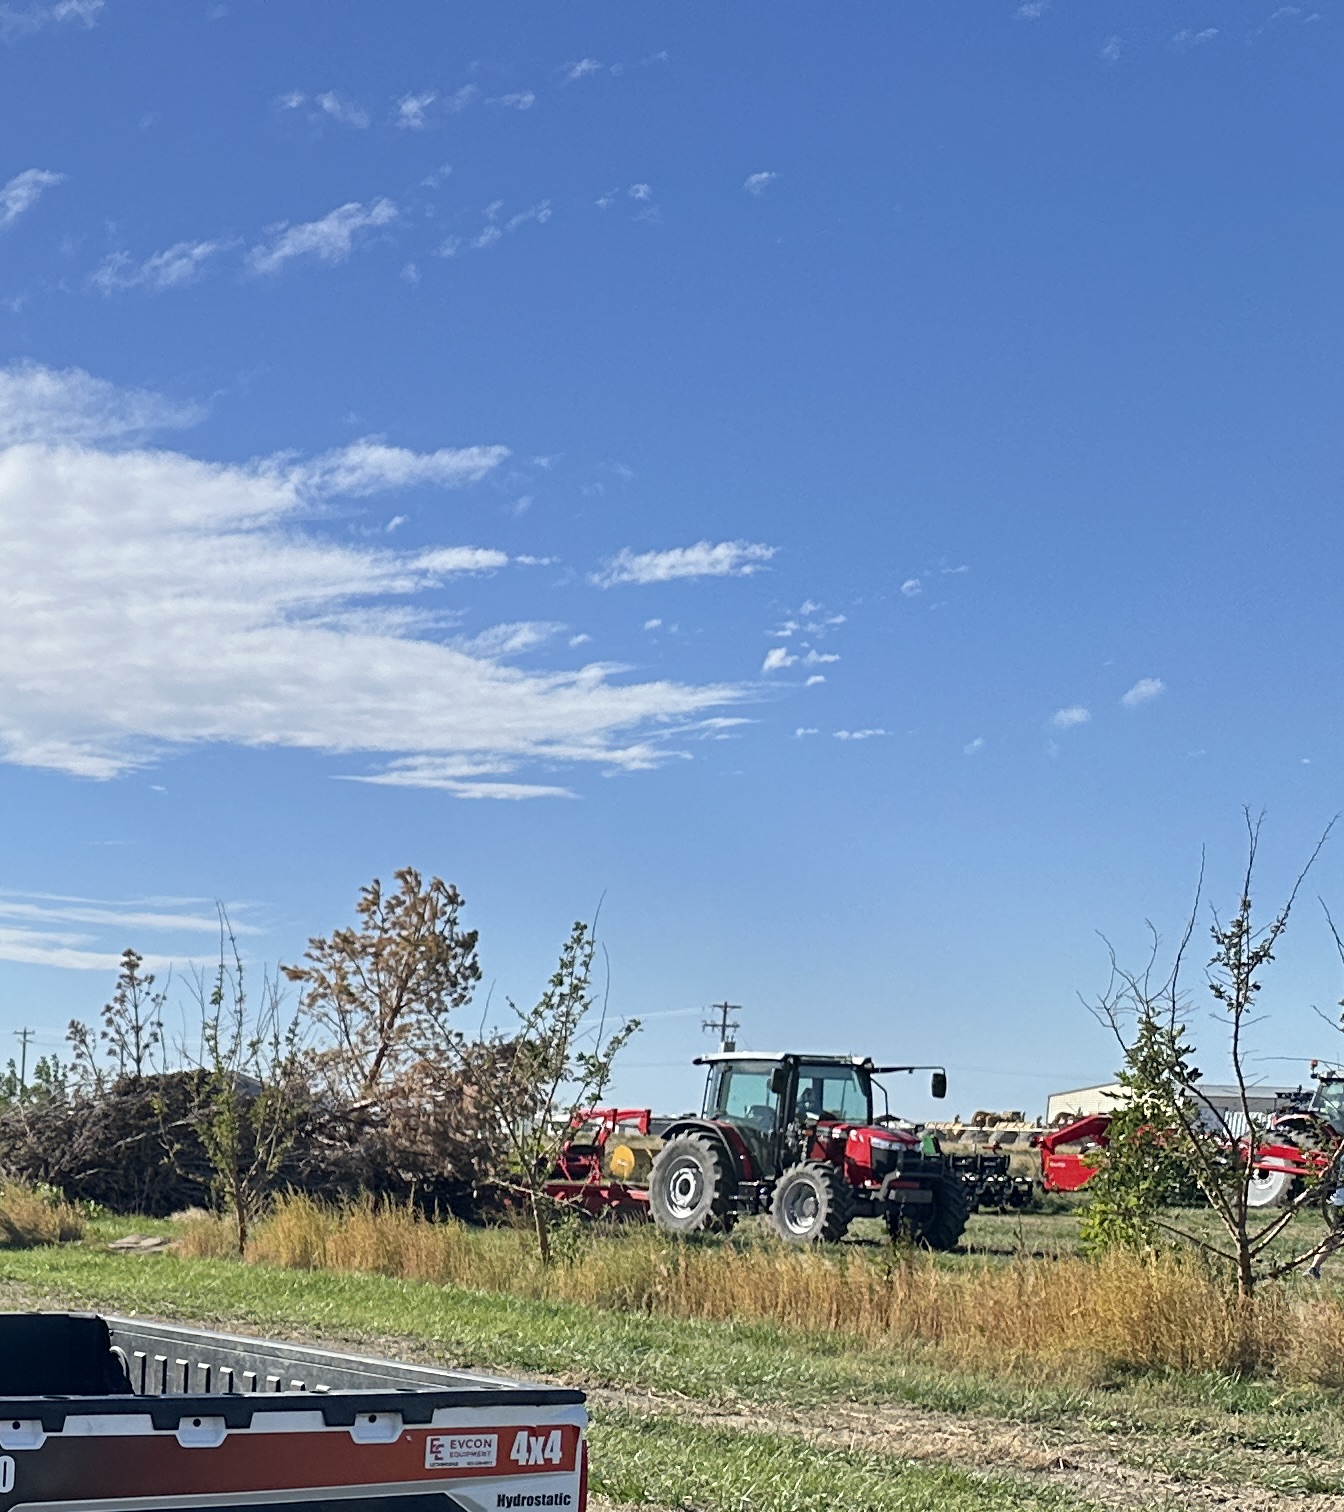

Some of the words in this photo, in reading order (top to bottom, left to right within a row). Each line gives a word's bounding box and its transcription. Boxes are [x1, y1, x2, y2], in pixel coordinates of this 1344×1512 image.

[450, 1439, 492, 1449] EVCON
[510, 1430, 562, 1466] 4x4
[496, 1493, 572, 1509] Hydrostatic
